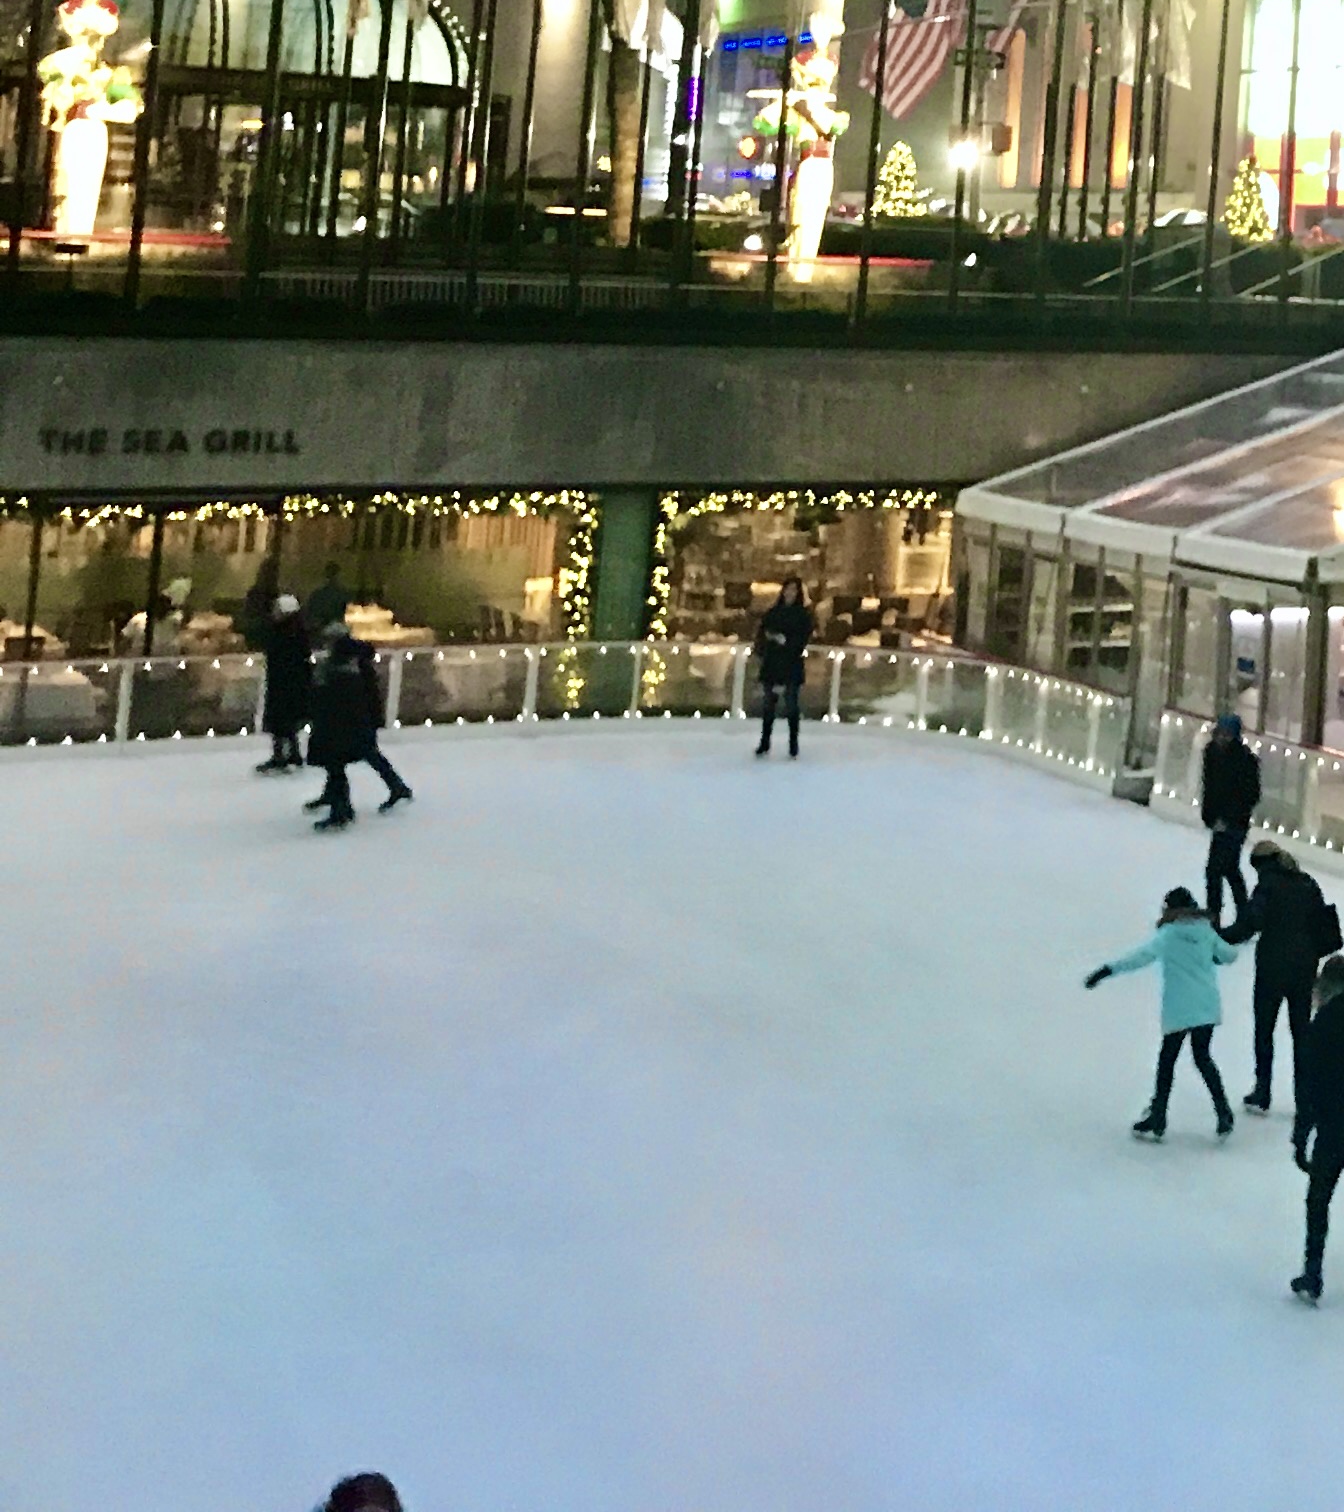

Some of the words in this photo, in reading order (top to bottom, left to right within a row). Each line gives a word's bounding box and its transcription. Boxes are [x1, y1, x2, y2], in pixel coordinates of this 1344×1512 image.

[38, 428, 108, 455] THE
[123, 428, 189, 455] SEA
[204, 428, 299, 455] GRILL
